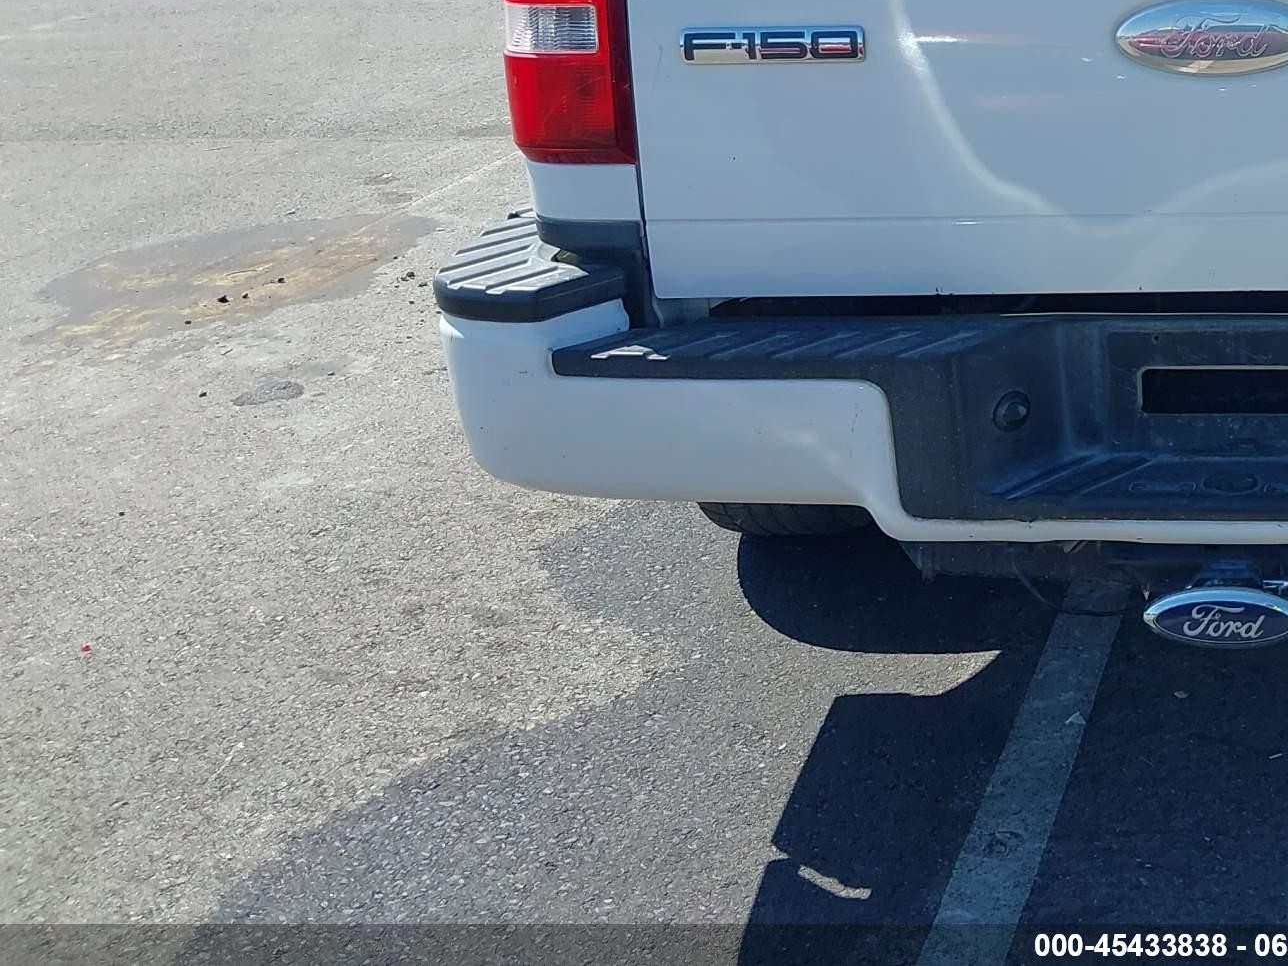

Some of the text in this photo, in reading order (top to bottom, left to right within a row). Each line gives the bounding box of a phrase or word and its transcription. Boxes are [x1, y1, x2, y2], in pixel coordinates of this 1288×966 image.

[683, 30, 860, 61] F-150
[1161, 14, 1268, 58] Ford
[1183, 604, 1266, 638] Ford
